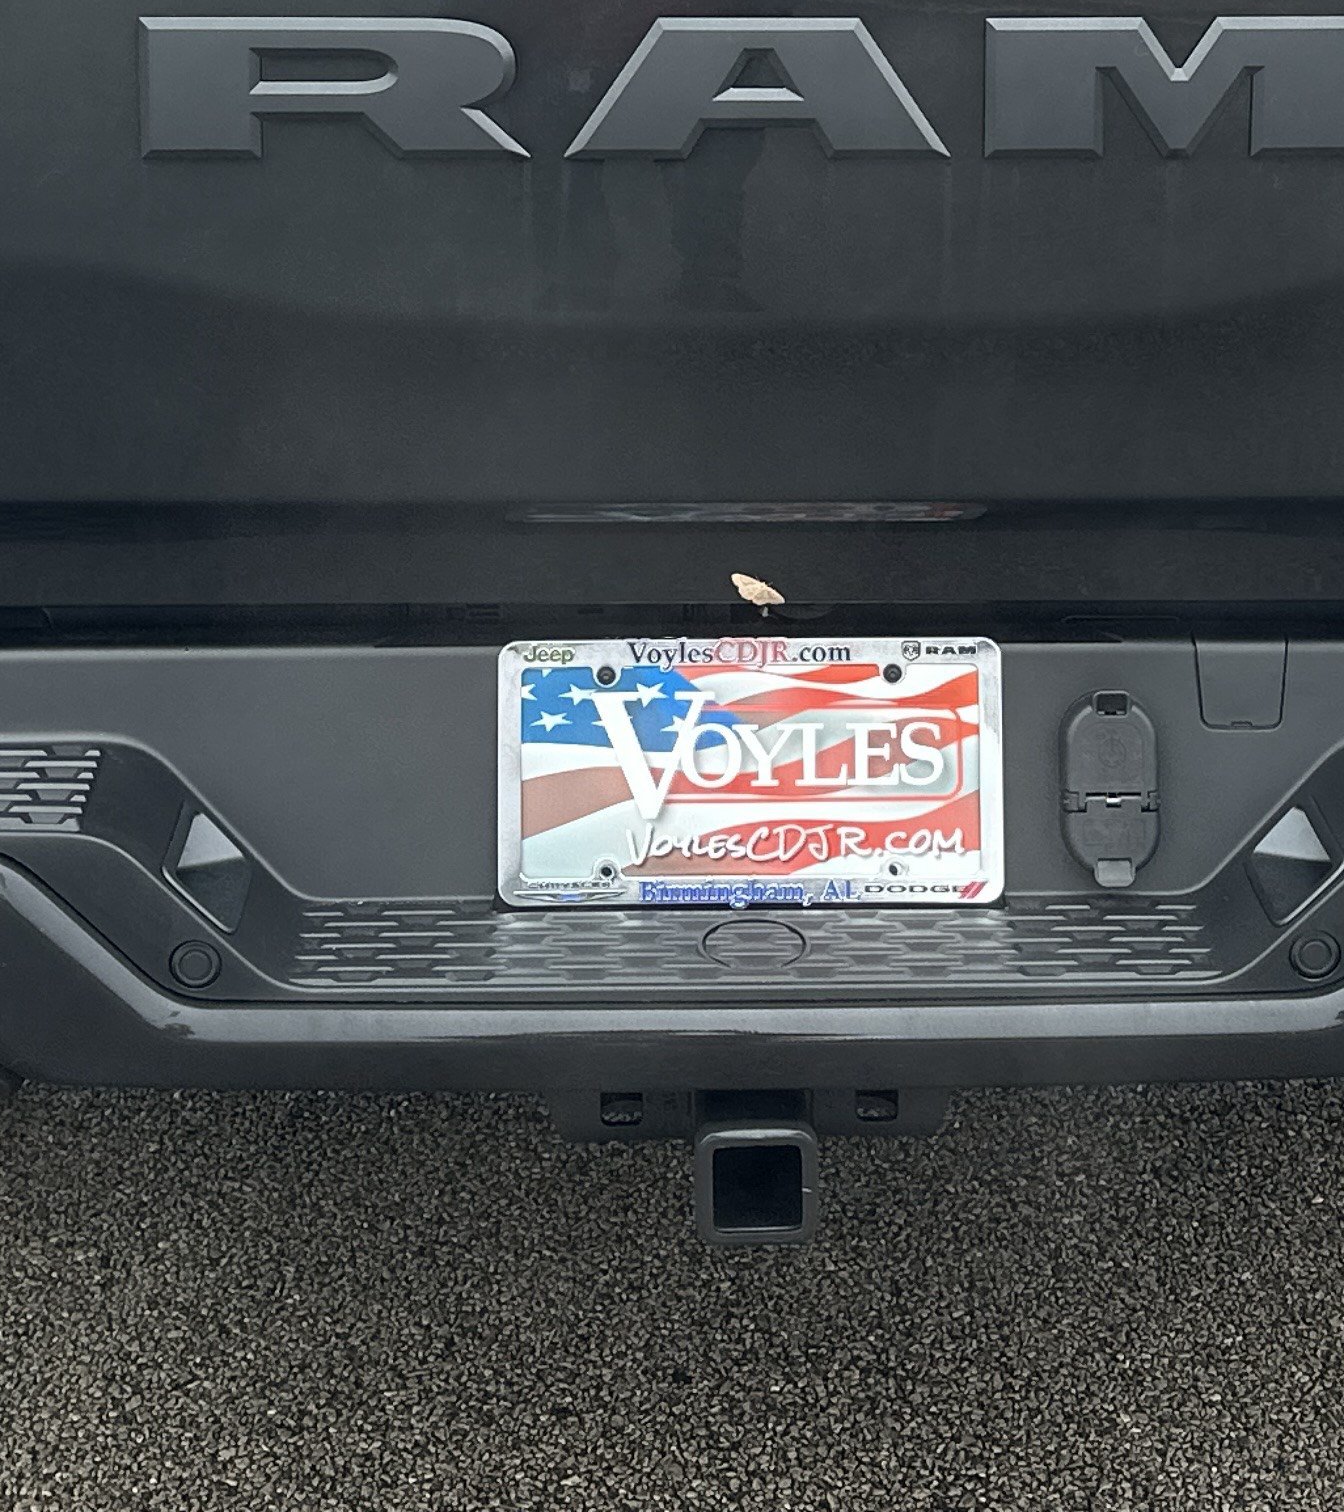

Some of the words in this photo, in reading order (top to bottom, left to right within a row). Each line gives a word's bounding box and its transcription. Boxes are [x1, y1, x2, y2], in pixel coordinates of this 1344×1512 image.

[522, 643, 575, 665] Jeep
[628, 639, 851, 668] VoylesCDJR.com
[925, 645, 977, 656] RAM
[638, 879, 812, 908] Birmingham,
[820, 879, 861, 901] AL
[864, 884, 963, 894] DODGE
